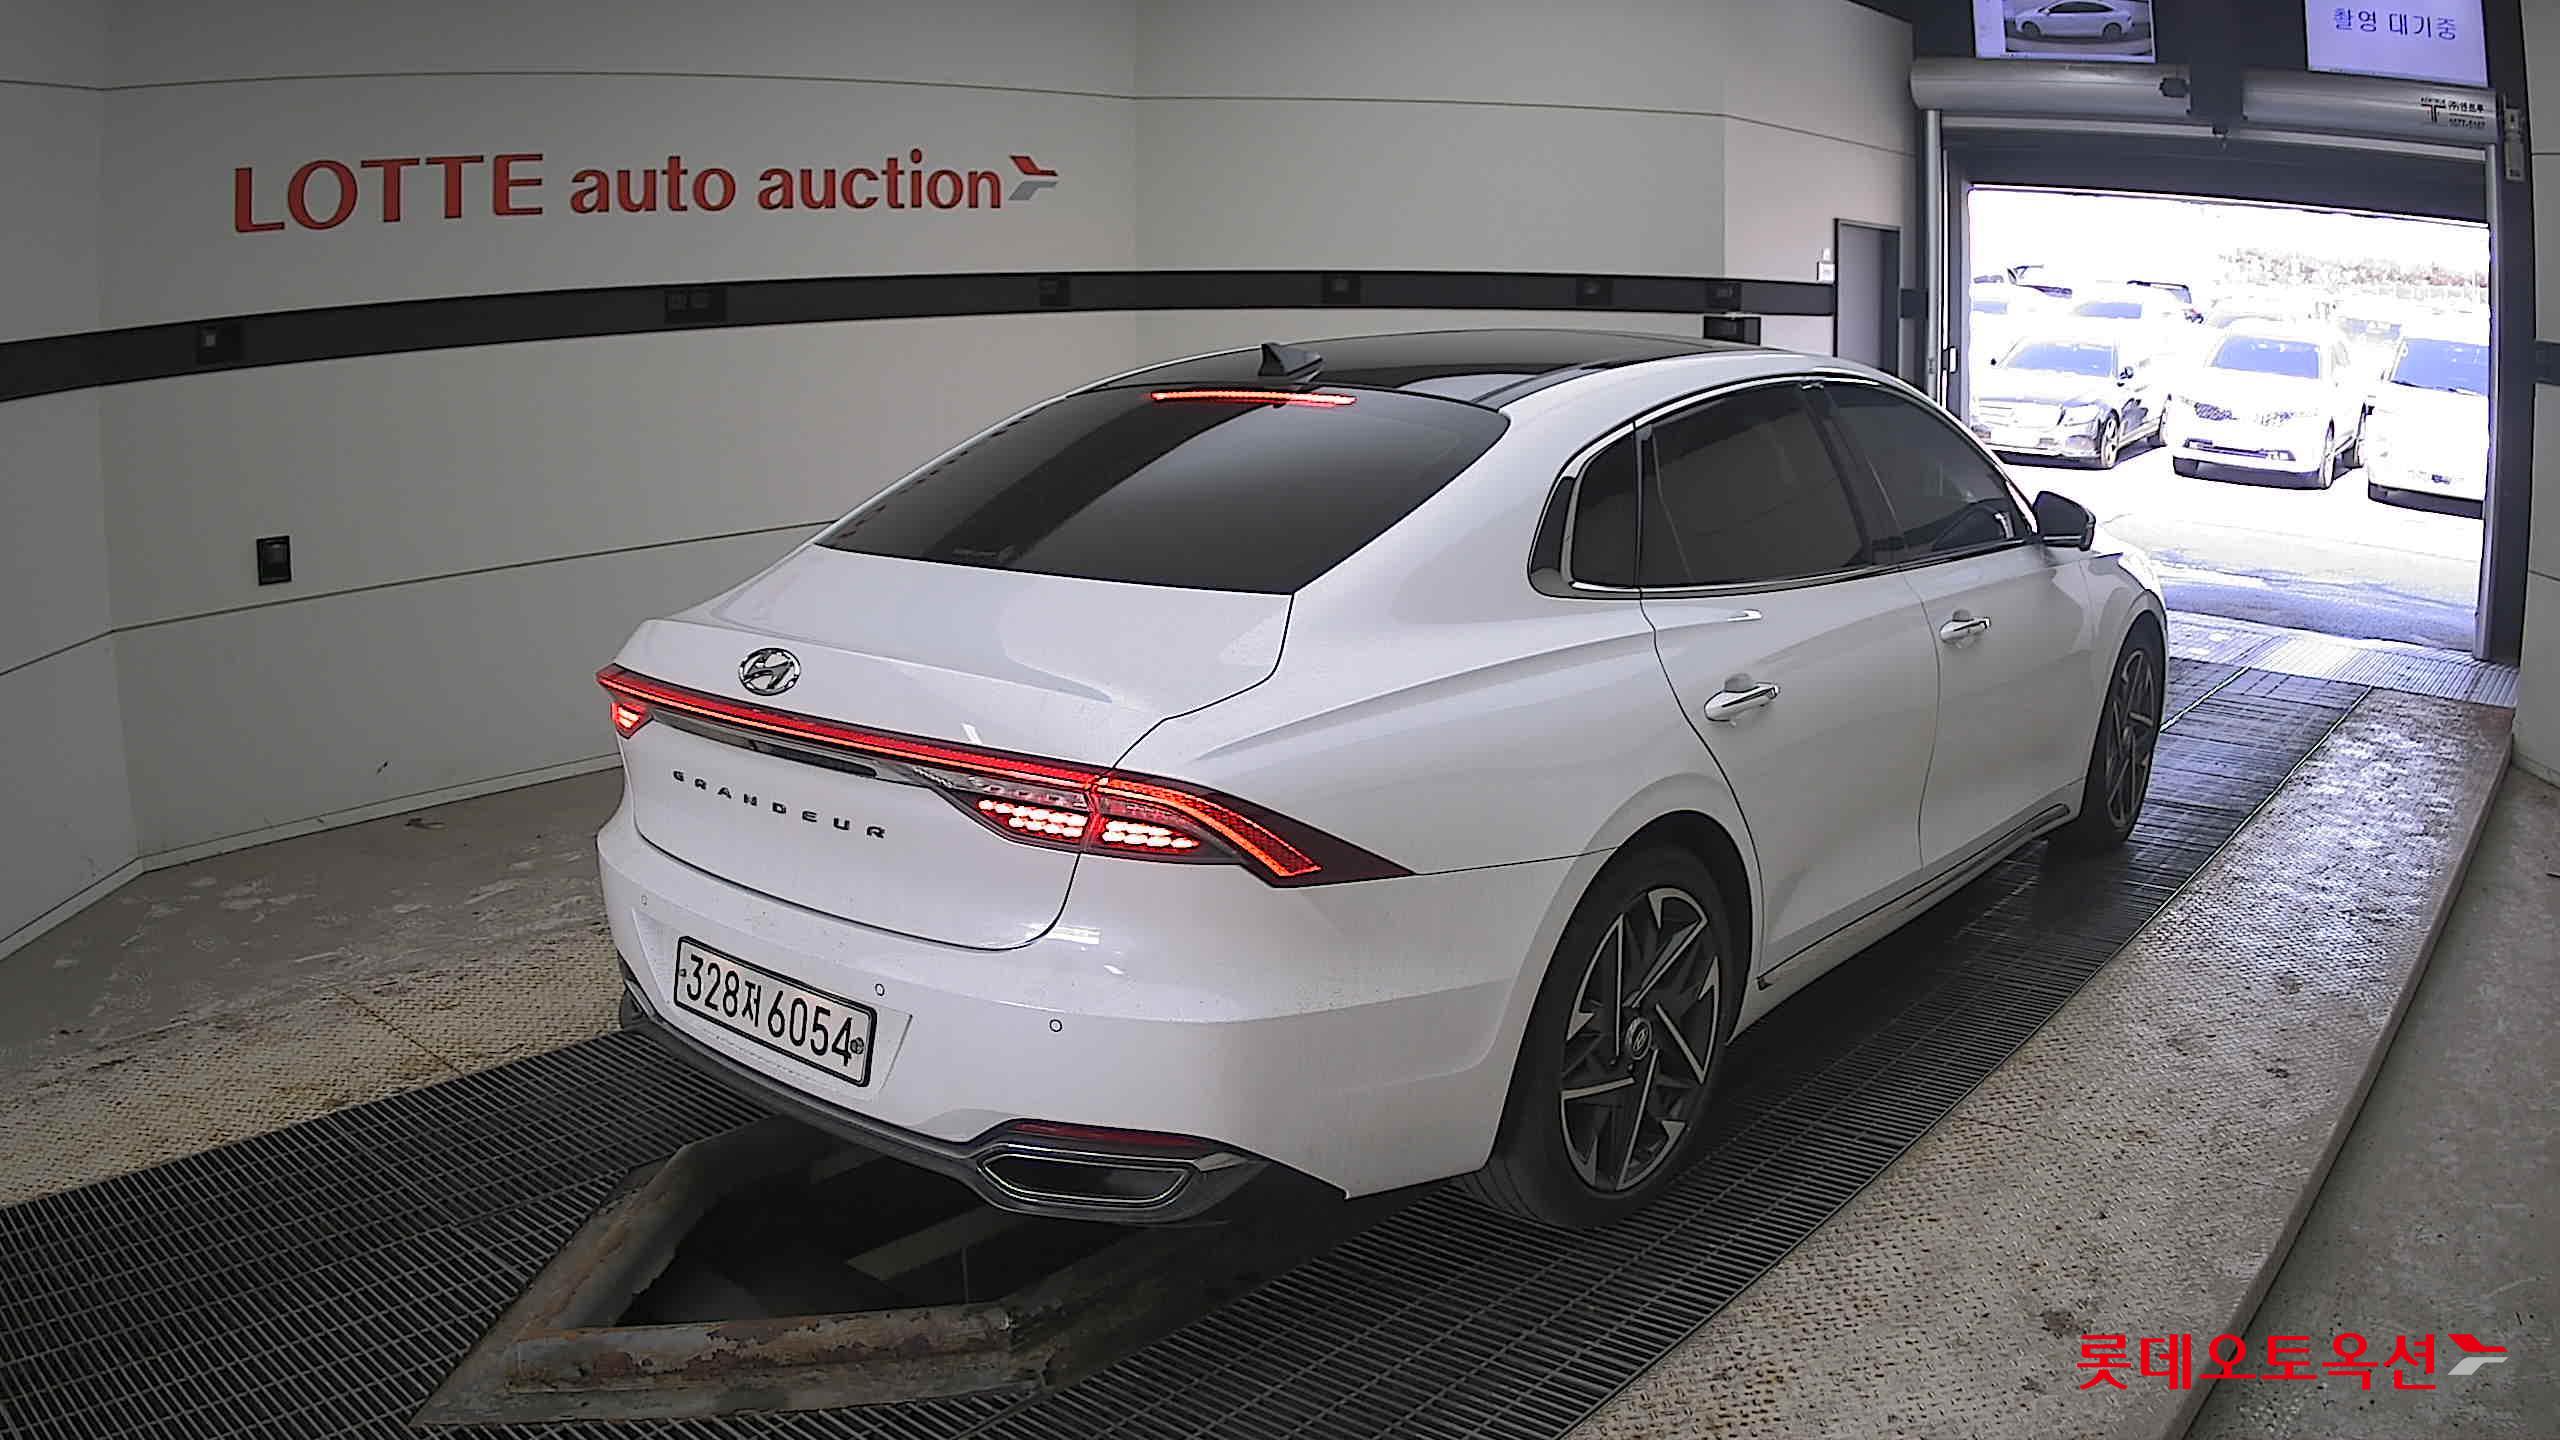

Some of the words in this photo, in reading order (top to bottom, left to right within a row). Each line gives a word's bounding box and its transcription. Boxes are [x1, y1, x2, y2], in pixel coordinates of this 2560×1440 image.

[2388, 13, 2457, 41] 대기중
[234, 153, 544, 233] LOTTE
[569, 156, 737, 214] auto
[757, 149, 1002, 210] auction
[673, 769, 887, 839] GRANDEUR
